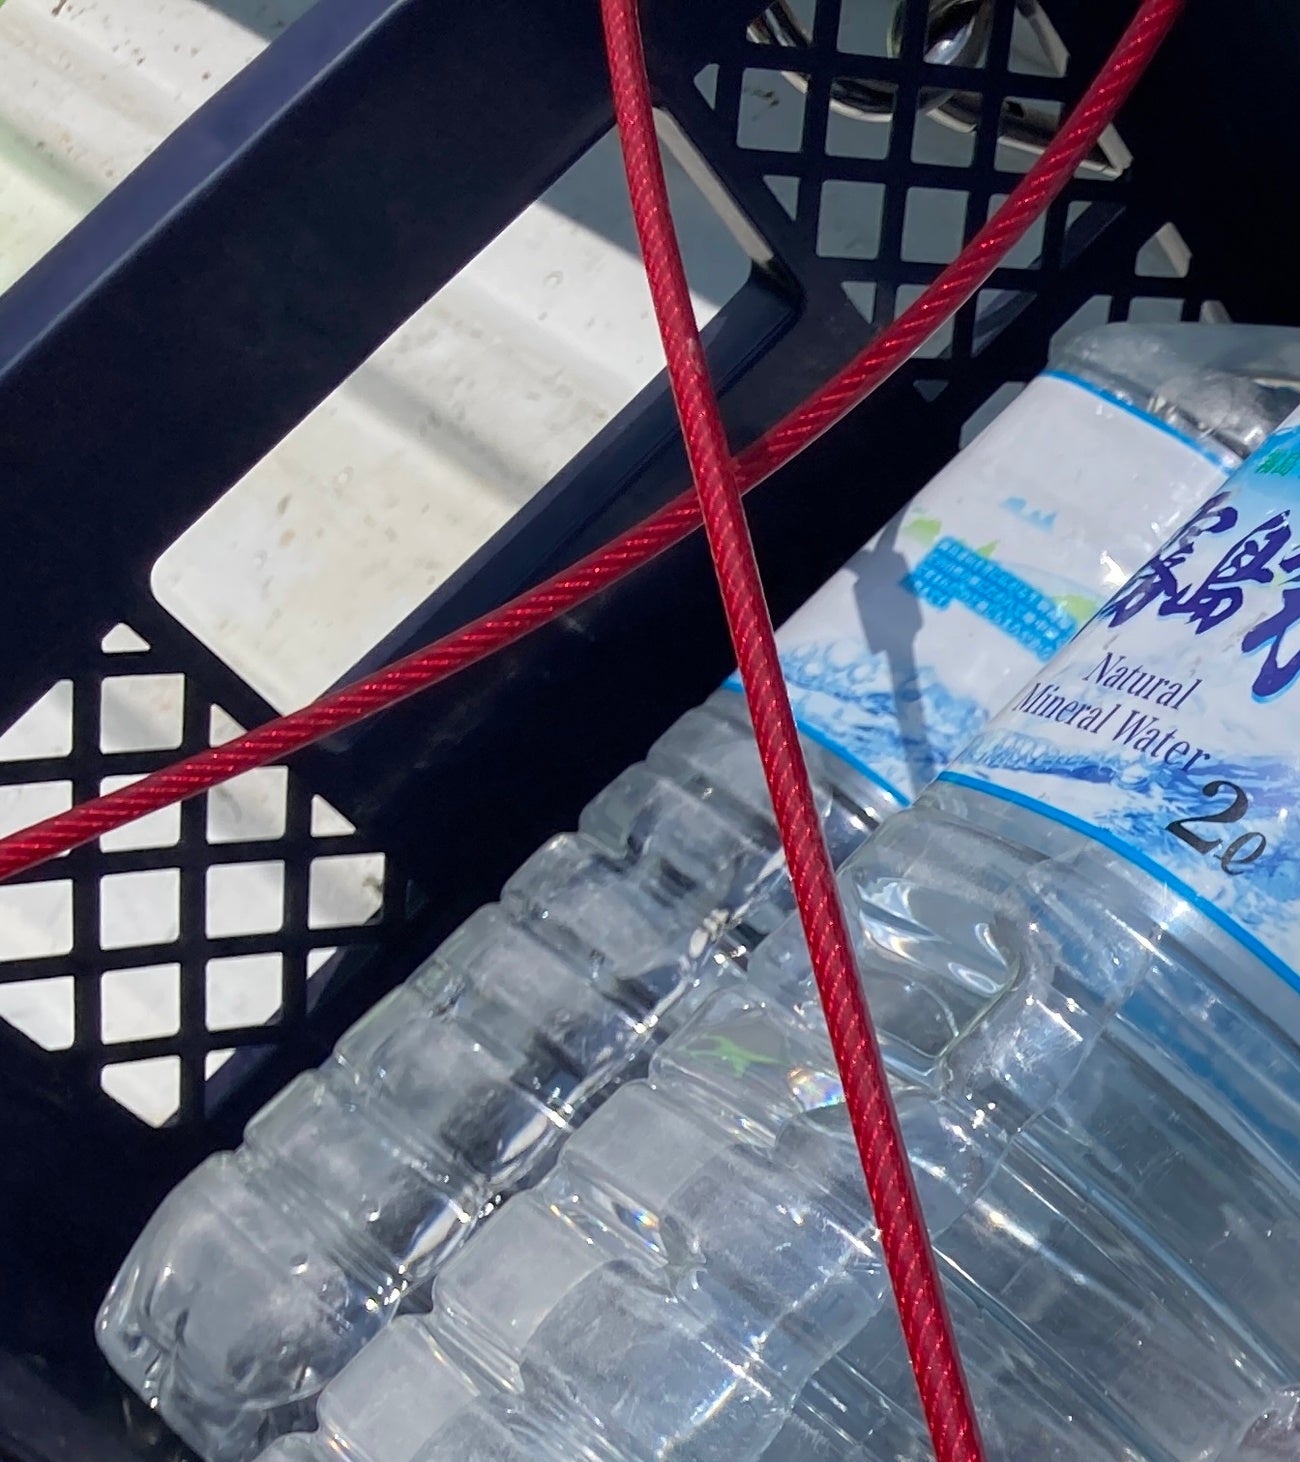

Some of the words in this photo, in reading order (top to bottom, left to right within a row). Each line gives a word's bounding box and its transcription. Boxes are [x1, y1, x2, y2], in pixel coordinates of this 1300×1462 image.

[1081, 652, 1202, 710] Natural
[1012, 683, 1121, 734] Mineral
[1112, 710, 1212, 772] Water
